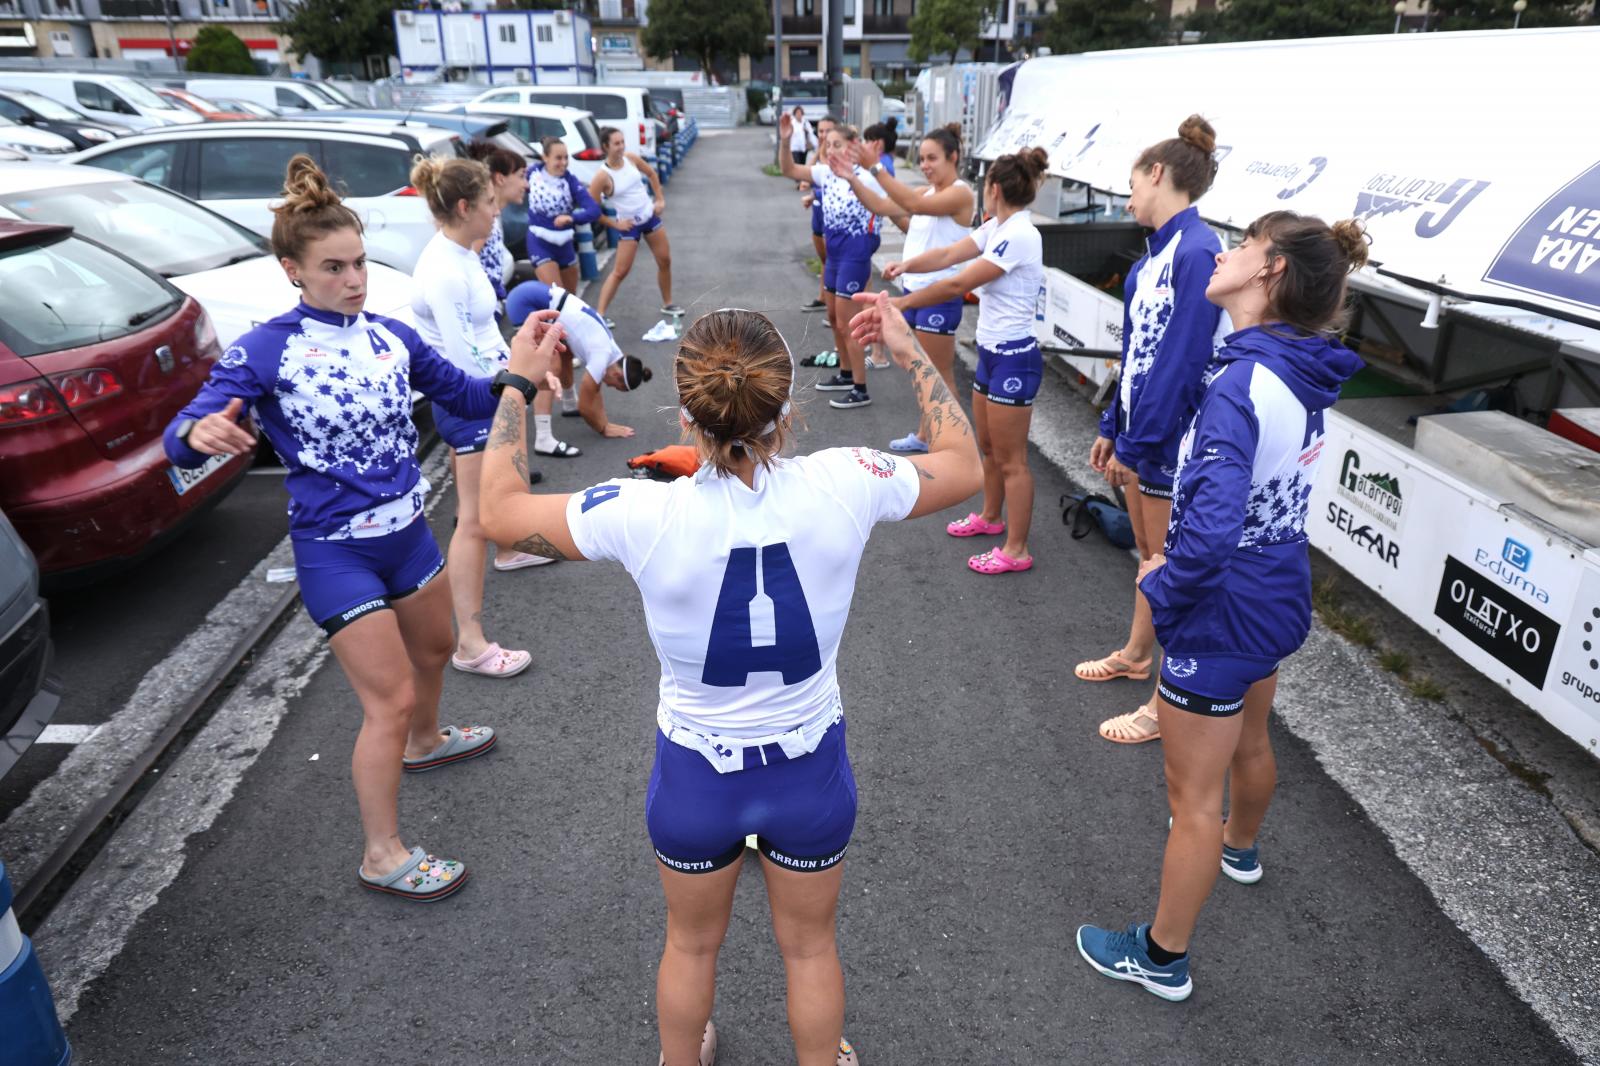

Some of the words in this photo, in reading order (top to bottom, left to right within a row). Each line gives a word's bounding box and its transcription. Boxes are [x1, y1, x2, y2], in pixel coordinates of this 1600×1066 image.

[1145, 486, 1174, 497] LAGUNA
[1474, 547, 1550, 605] Edyma
[341, 599, 386, 622] DONOSTIA
[701, 541, 823, 688] A
[1450, 578, 1541, 654] OLATXO
[1210, 699, 1244, 712] DONOS
[769, 850, 817, 868] ARRAUN
